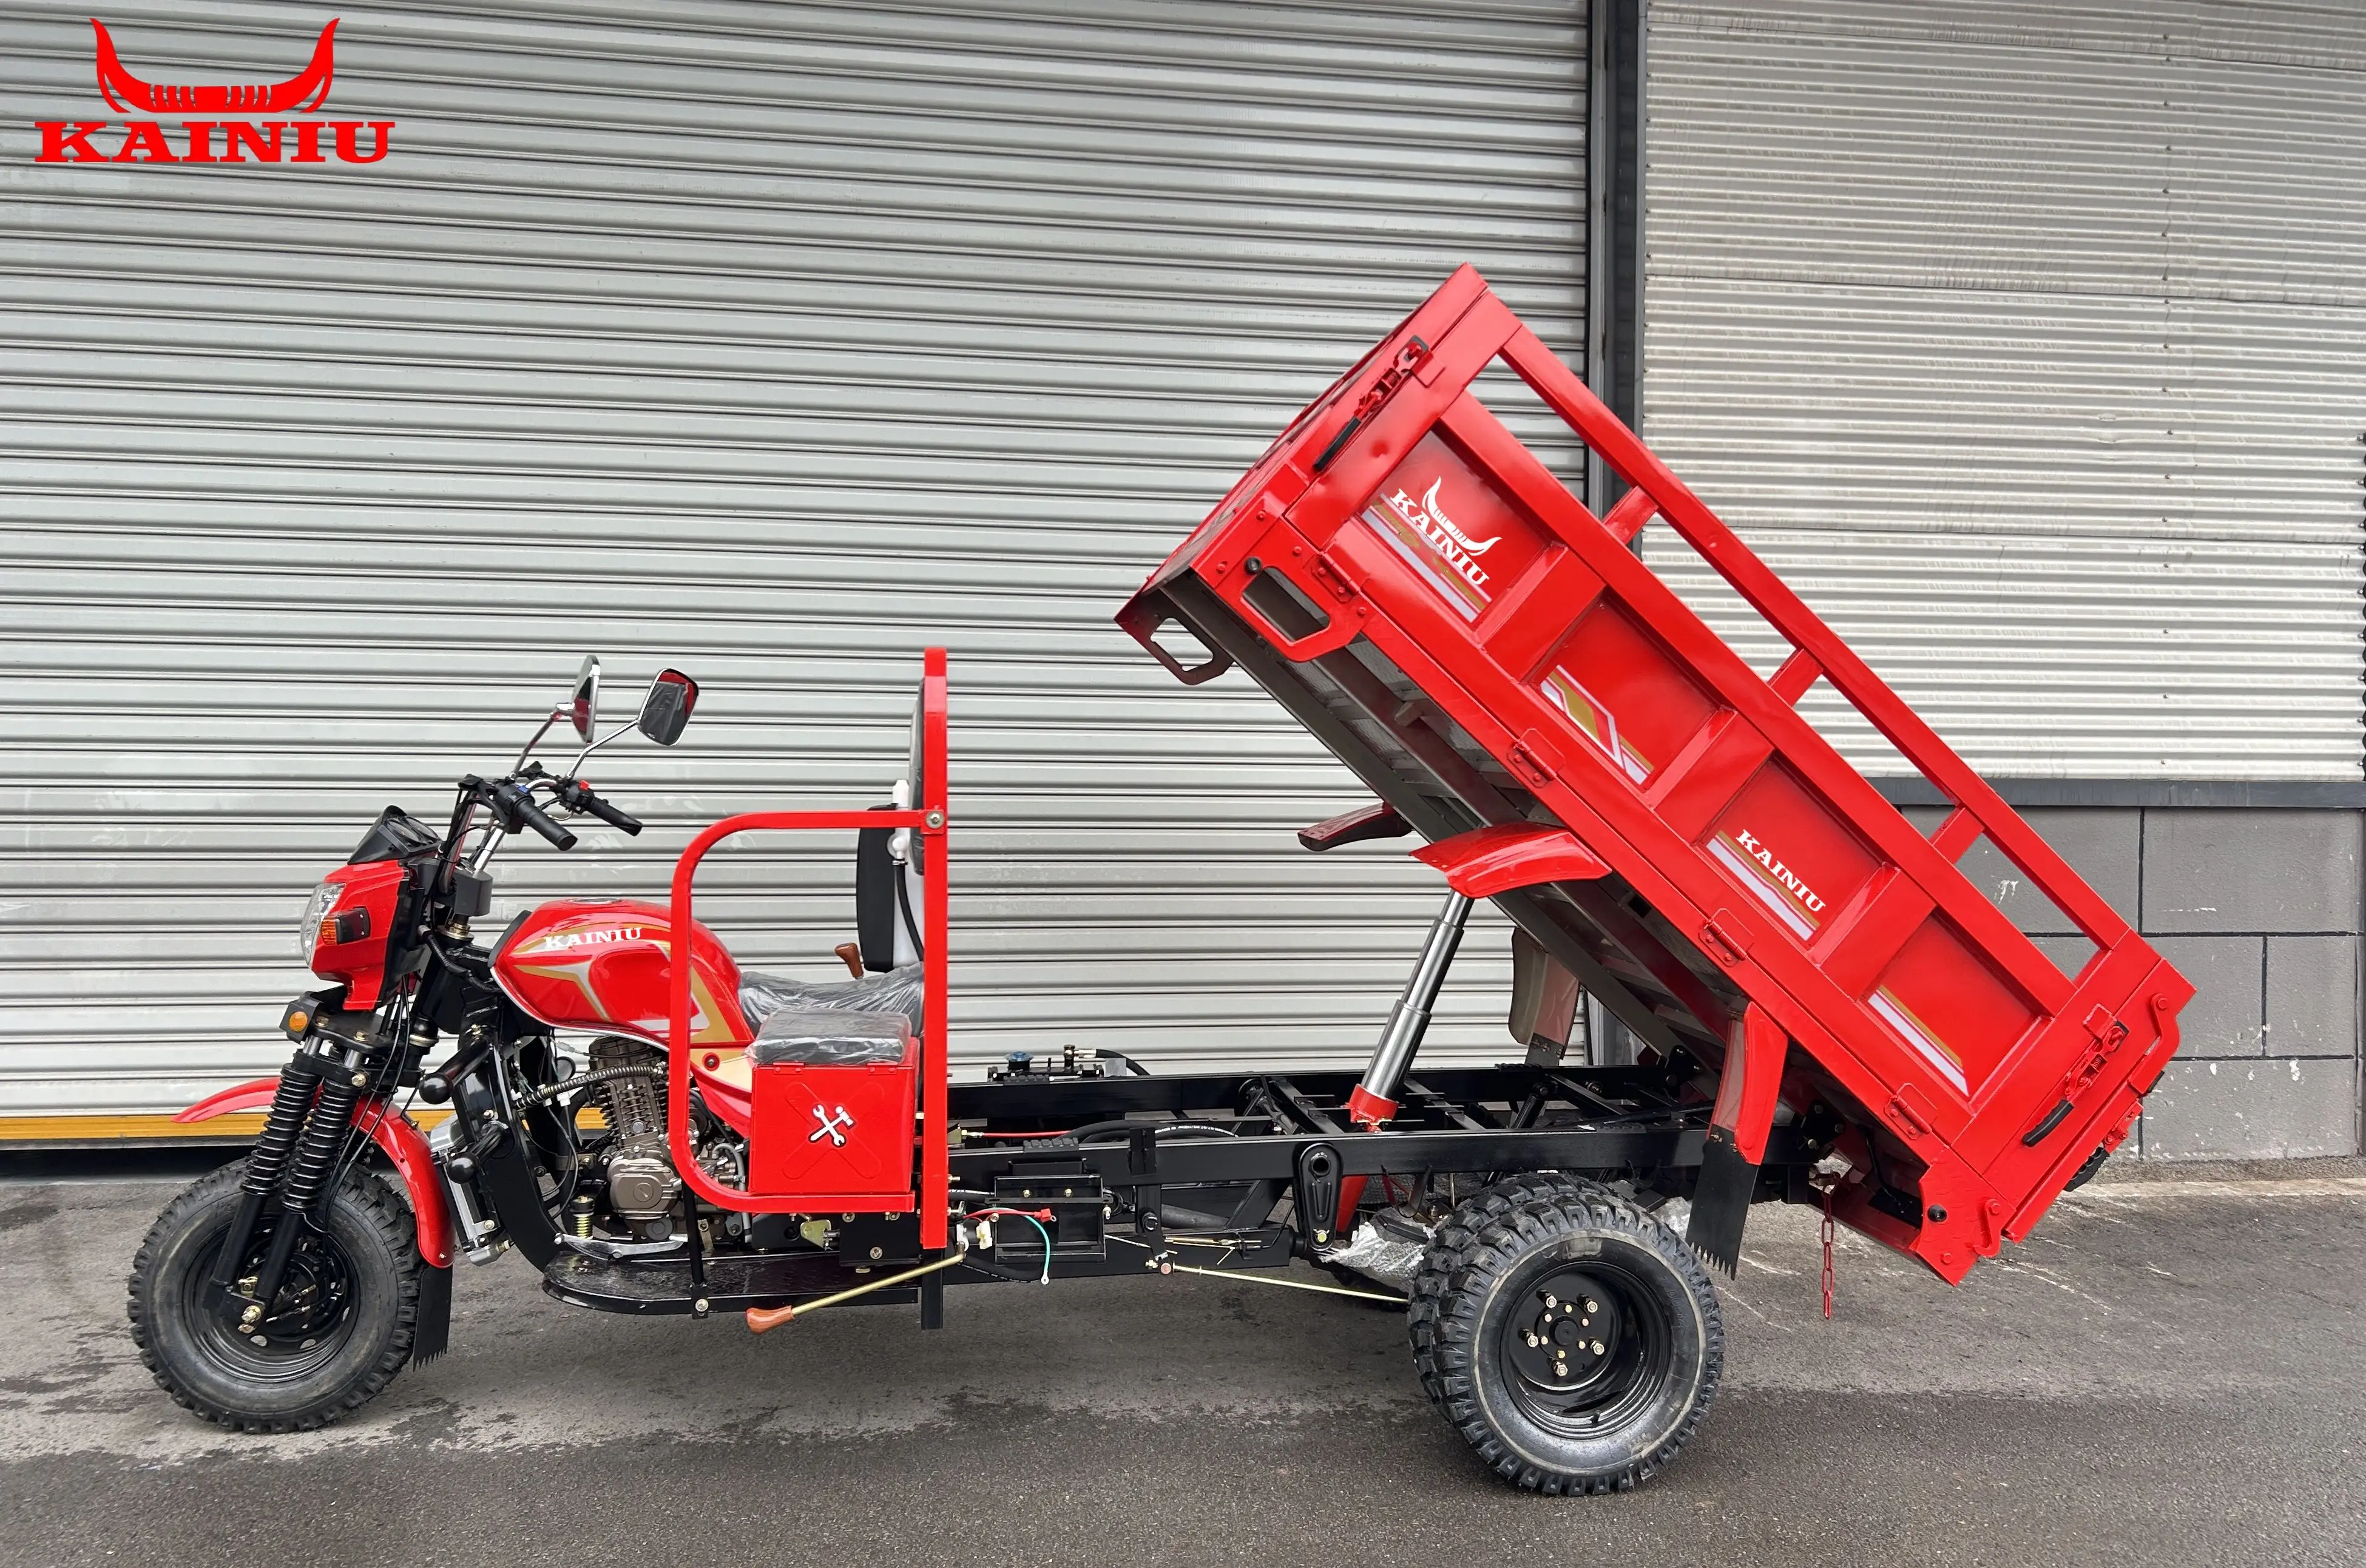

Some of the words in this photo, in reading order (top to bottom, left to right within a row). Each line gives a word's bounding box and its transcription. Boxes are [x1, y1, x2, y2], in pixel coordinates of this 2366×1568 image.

[1390, 488, 1490, 586] KAINIU
[1735, 829, 1826, 912] KAINIU
[545, 927, 642, 949] KAINIU
